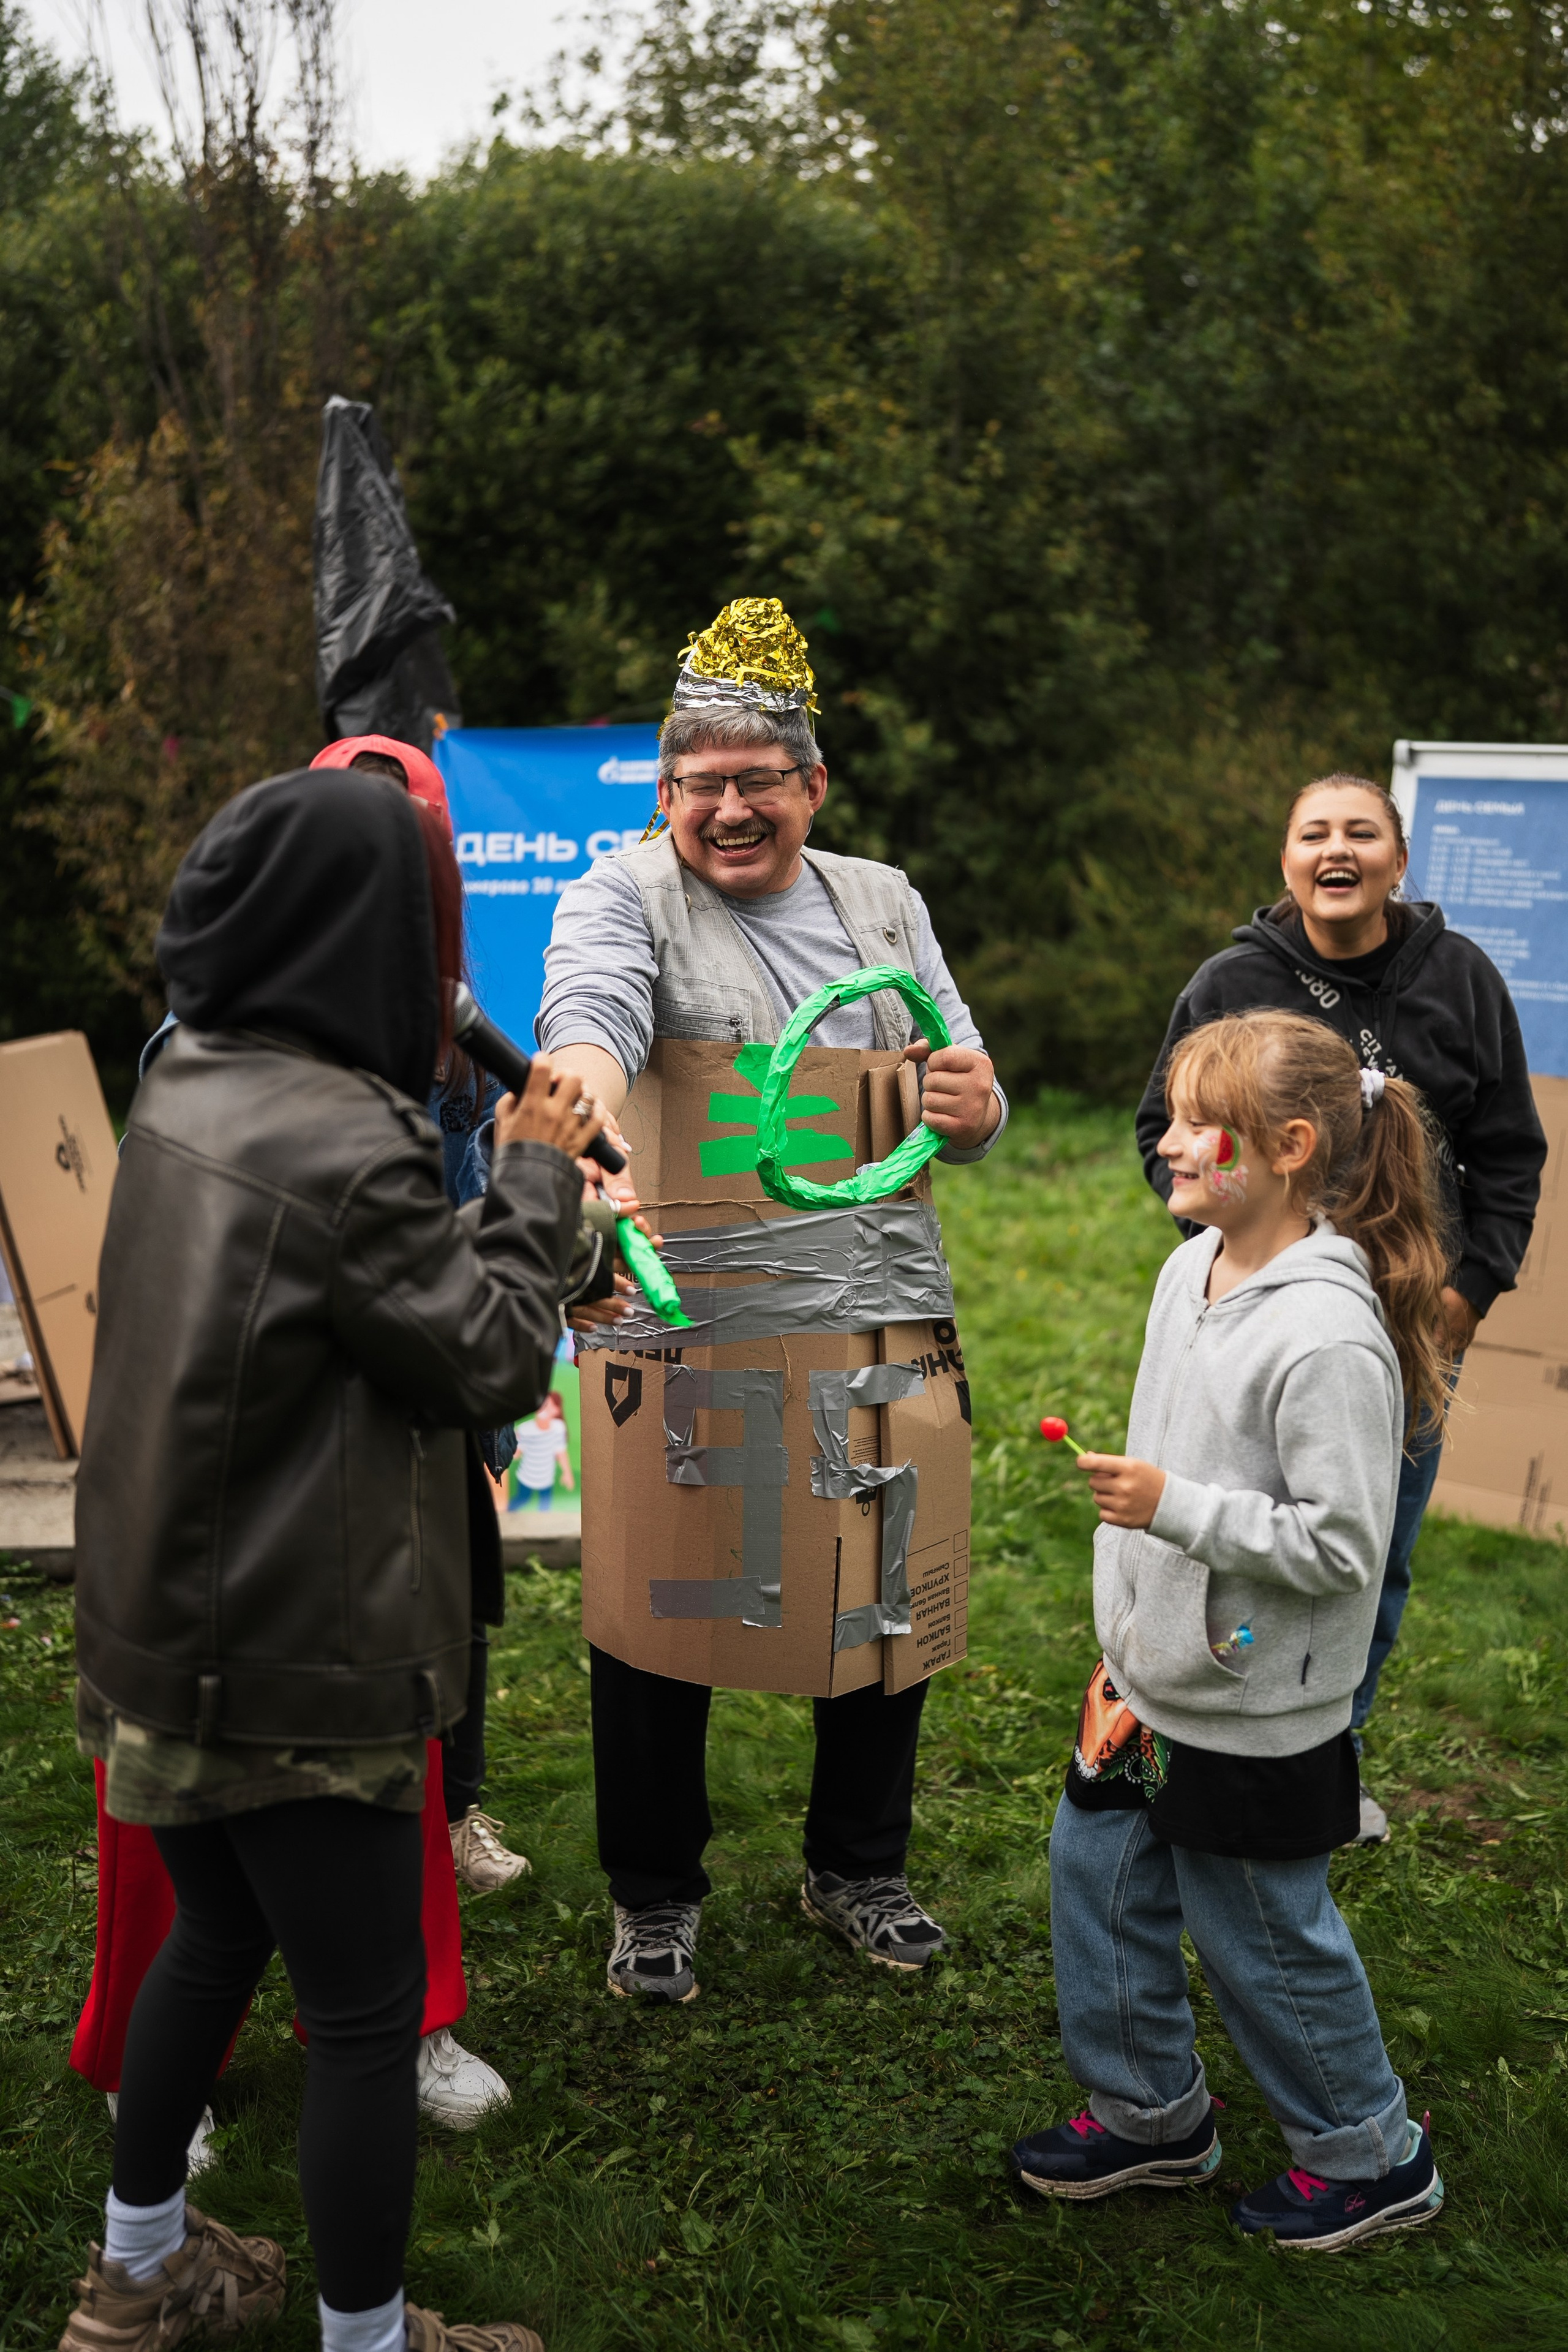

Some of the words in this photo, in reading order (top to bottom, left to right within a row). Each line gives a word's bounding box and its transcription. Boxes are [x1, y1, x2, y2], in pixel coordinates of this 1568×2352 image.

[456, 831, 578, 867] ДЕНЬ
[910, 1573, 949, 1597] ХРУПКОЕ
[928, 1587, 950, 1601] Ванная
[916, 1597, 950, 1621] ВАННАЯ
[928, 1613, 950, 1629] Балкон
[917, 1624, 950, 1648] БАЛКОН
[932, 1639, 951, 1652] Гараж
[922, 1649, 951, 1671] ГАРАЖ
